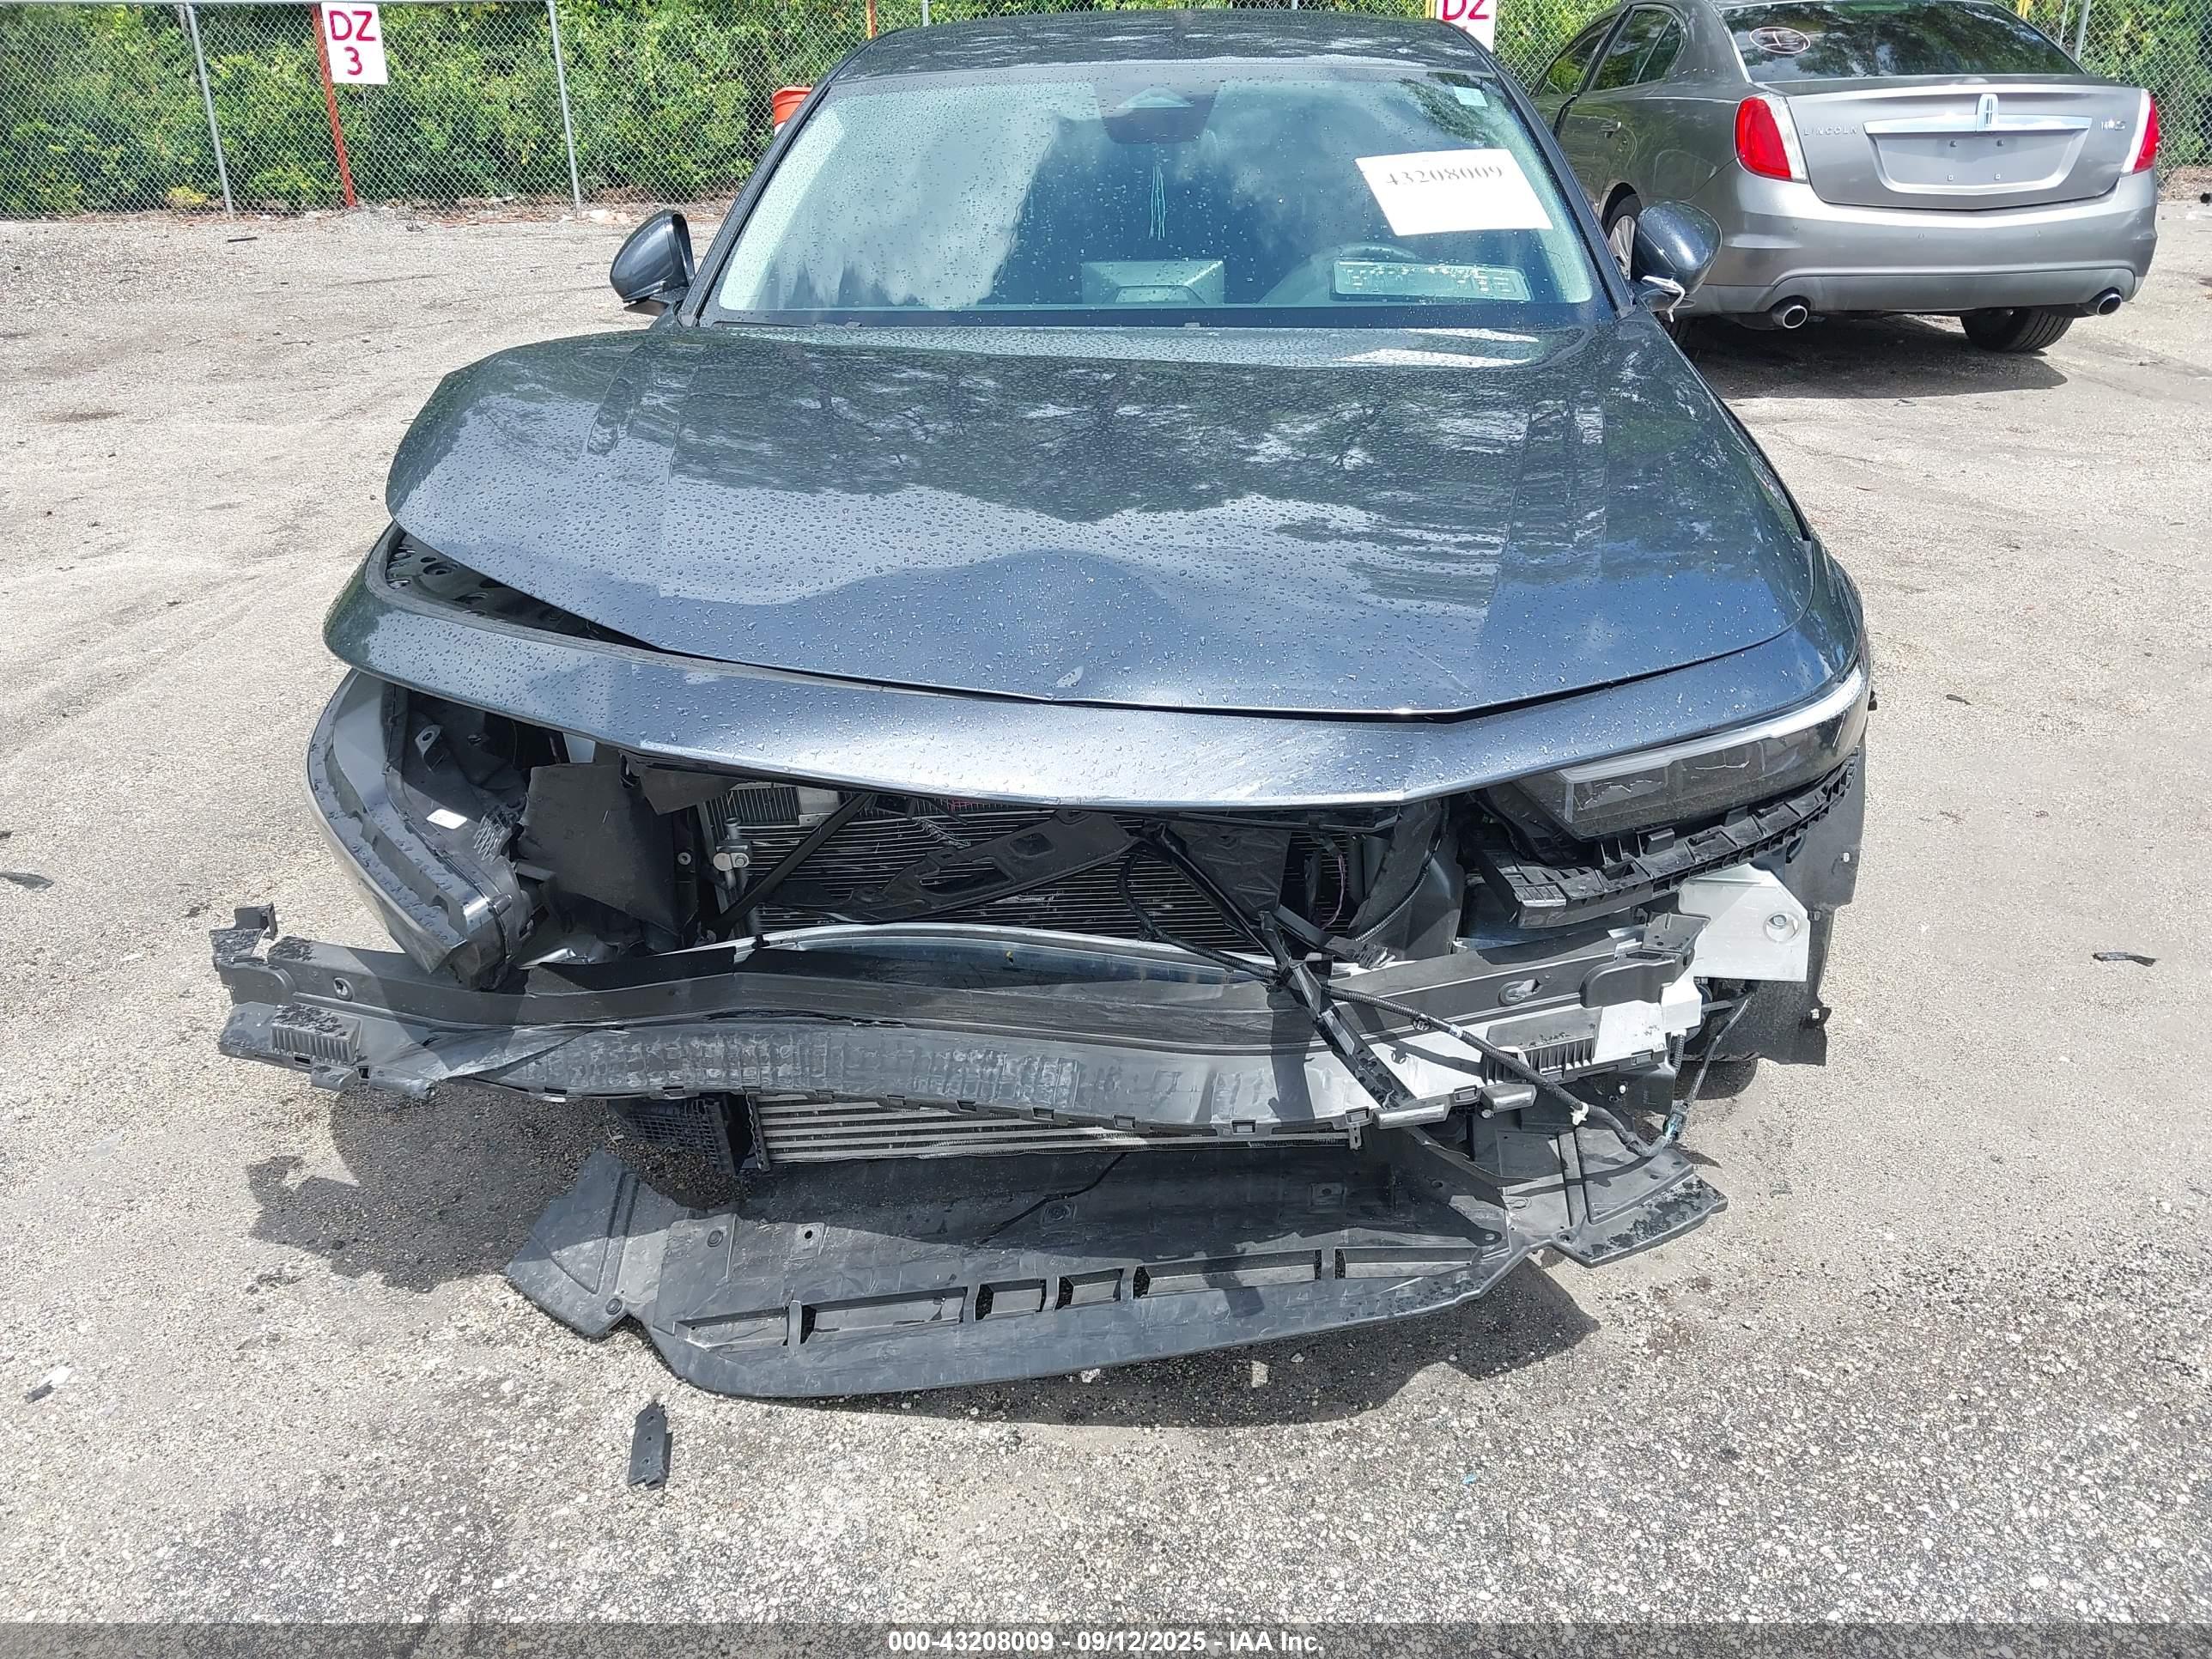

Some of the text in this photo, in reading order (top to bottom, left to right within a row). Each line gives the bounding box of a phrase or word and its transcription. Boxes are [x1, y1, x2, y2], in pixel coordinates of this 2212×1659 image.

[1443, 0, 1489, 21] DZ
[329, 9, 376, 41] DZ
[343, 46, 362, 76] 3
[1803, 125, 1857, 136] LINCOLN
[1387, 166, 1503, 185] 43208009
